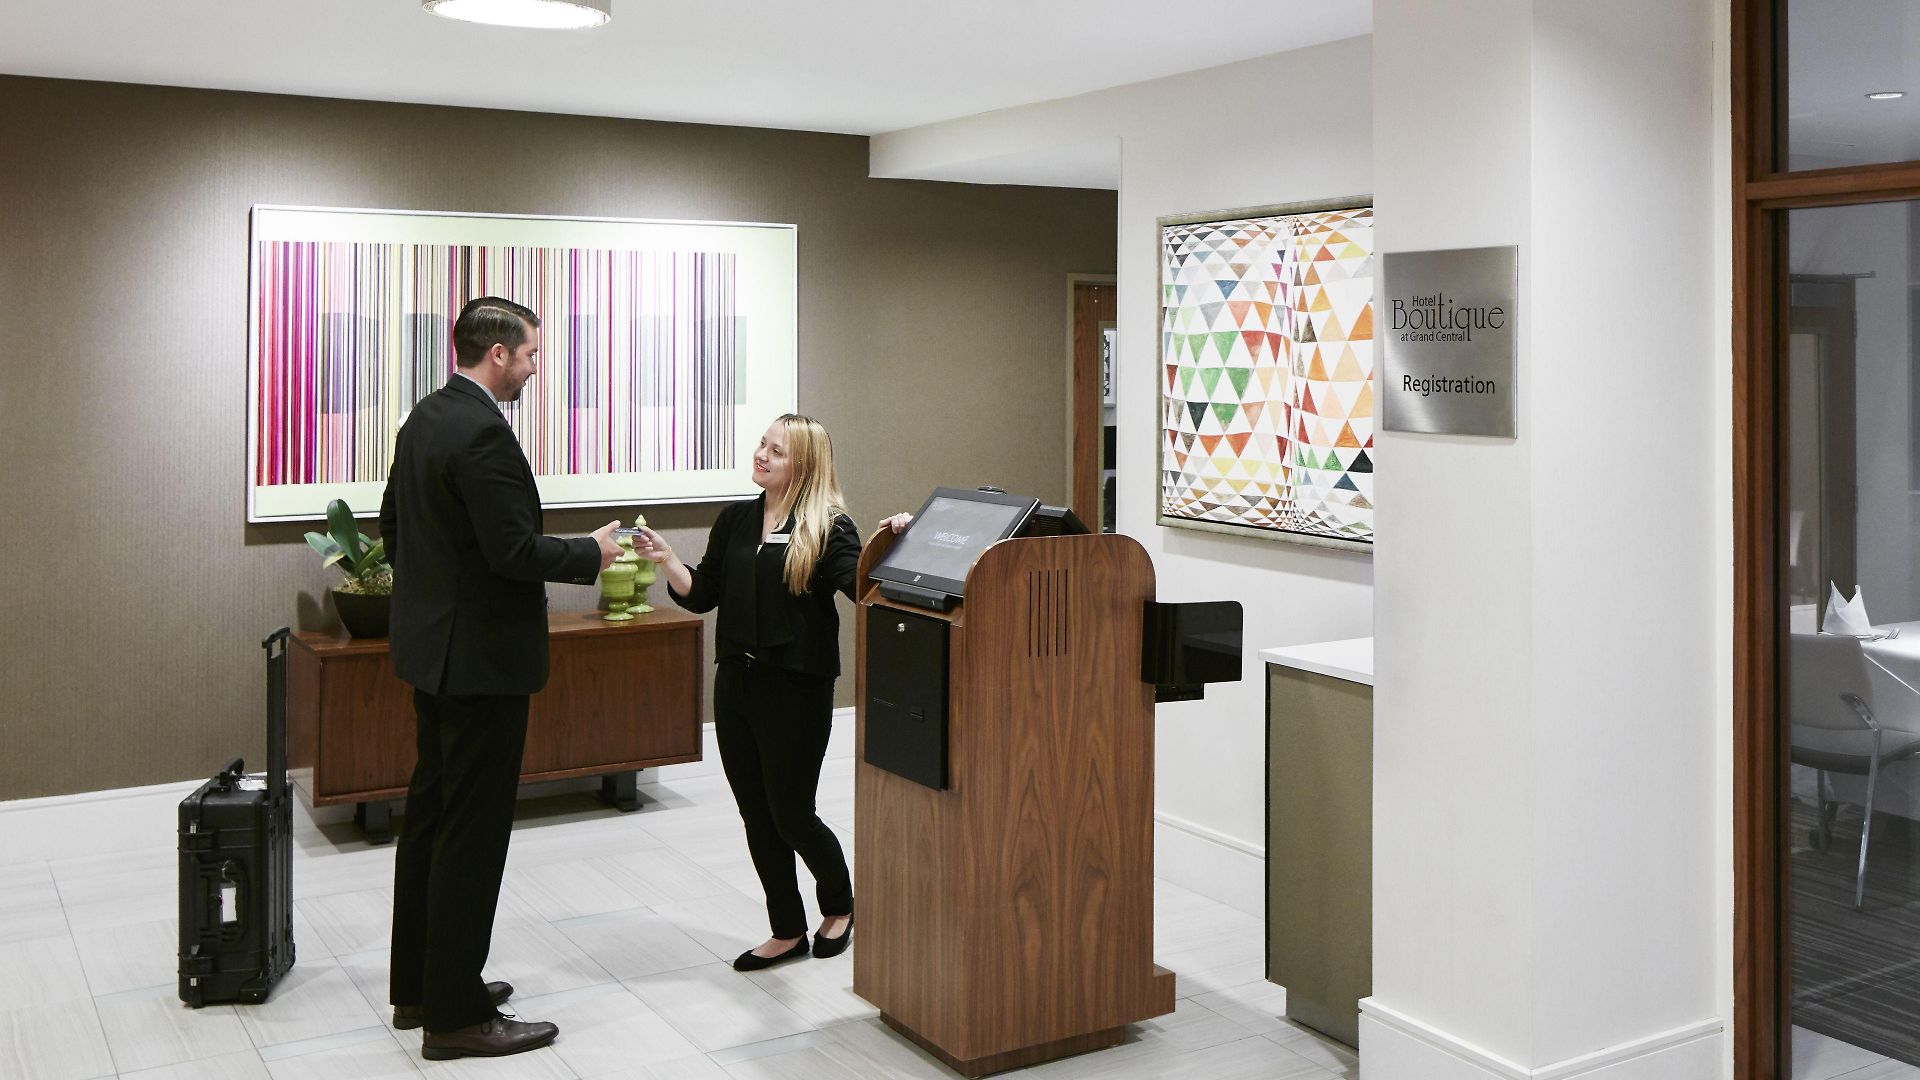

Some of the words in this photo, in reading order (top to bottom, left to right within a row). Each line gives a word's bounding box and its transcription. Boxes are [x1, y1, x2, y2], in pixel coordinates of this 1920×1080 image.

[1412, 295, 1436, 307] Hotel
[1392, 293, 1504, 341] Boutique
[1400, 333, 1408, 341] at
[1410, 331, 1434, 341] Grand
[1436, 331, 1465, 341] Central
[1403, 375, 1495, 396] Registration
